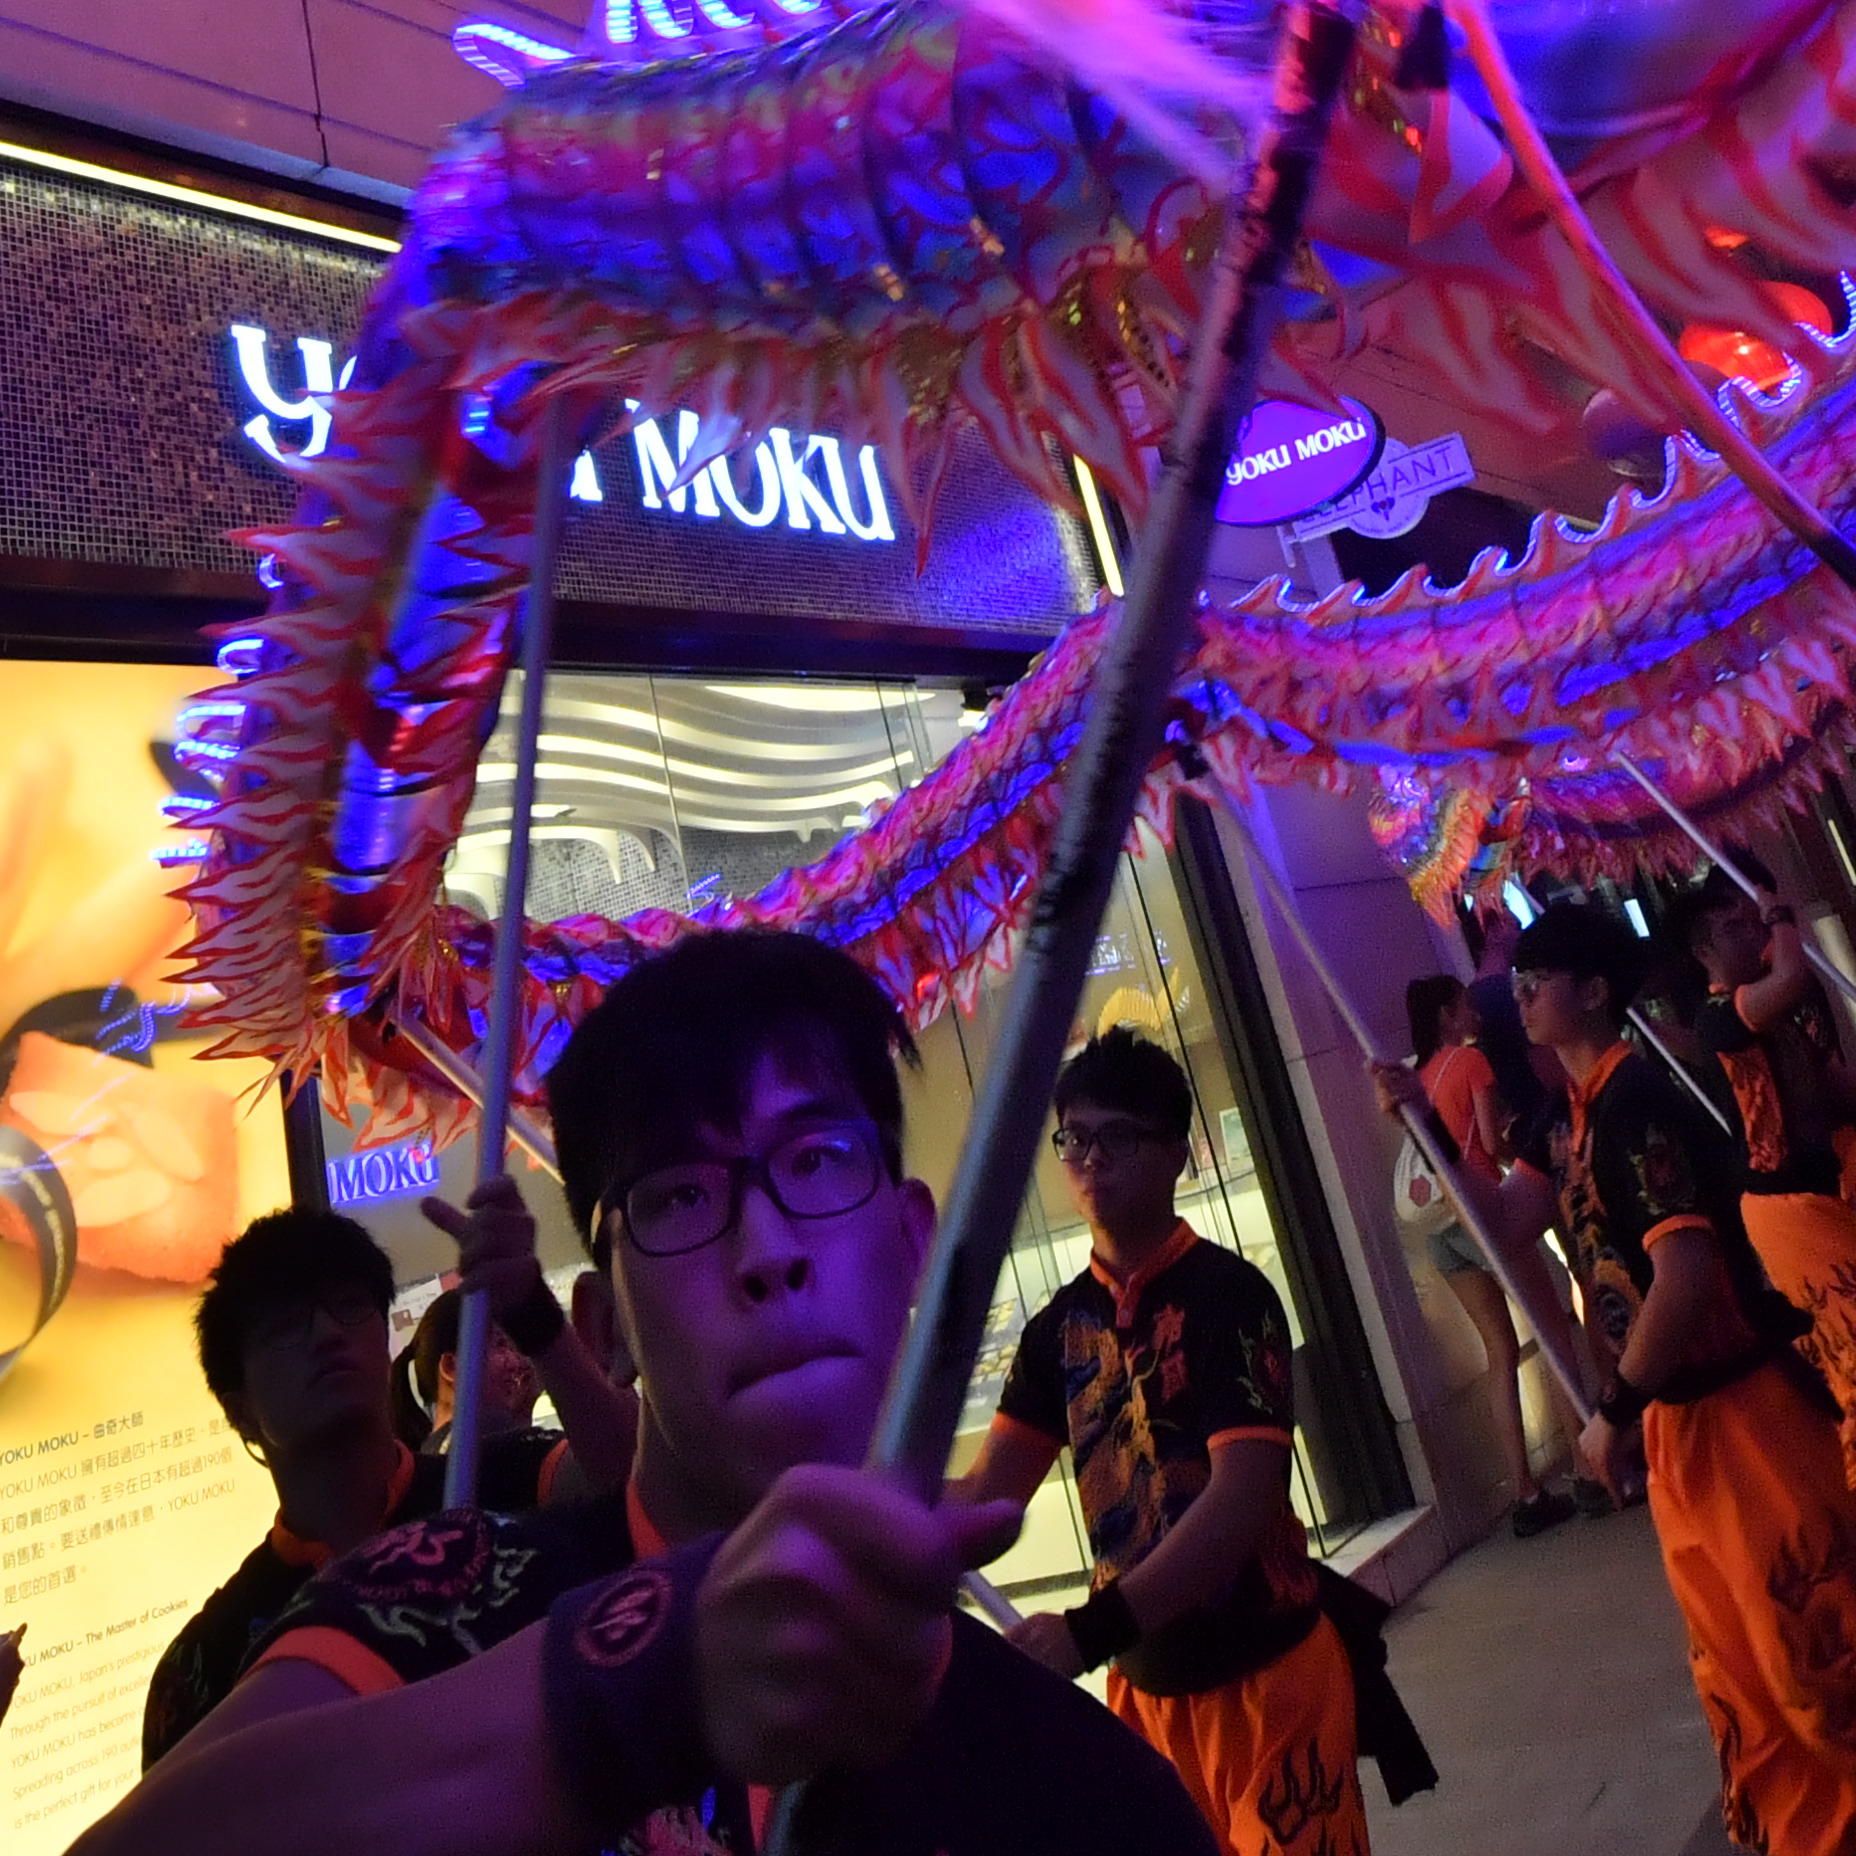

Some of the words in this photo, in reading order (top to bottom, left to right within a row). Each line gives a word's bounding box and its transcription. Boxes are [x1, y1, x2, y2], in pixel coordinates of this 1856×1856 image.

[624, 398, 895, 541] MOKU
[1225, 444, 1291, 486] YOKU
[1294, 417, 1366, 461] MOKU
[328, 1143, 439, 1204] MOKU
[37, 1431, 79, 1455] MOKU
[93, 1411, 144, 1440] 曲奇大師
[0, 1476, 34, 1501] YOKU
[37, 1464, 77, 1490] MOKU
[168, 1489, 200, 1513] YOKU
[202, 1478, 236, 1501] MOKU
[40, 1640, 74, 1663] MOKU
[86, 1630, 103, 1651] The
[106, 1617, 138, 1637] Master
[140, 1610, 150, 1624] of
[151, 1598, 189, 1620] Cookies
[117, 1641, 165, 1672] prestigious
[10, 1715, 50, 1741] Through
[53, 1707, 70, 1722] the
[72, 1691, 106, 1717] pursuit
[107, 1687, 118, 1702] of
[11, 1745, 40, 1768] YOKU
[43, 1734, 76, 1757] MOKU
[78, 1726, 97, 1743] has
[99, 1708, 136, 1733] become
[13, 1768, 65, 1800] Spreading
[66, 1754, 99, 1778] across
[101, 1742, 118, 1761] 190
[14, 1817, 23, 1831] is
[24, 1807, 42, 1824] the
[43, 1790, 78, 1819] perfect
[80, 1779, 96, 1801] gift
[97, 1776, 113, 1792] for
[114, 1767, 135, 1790] your
